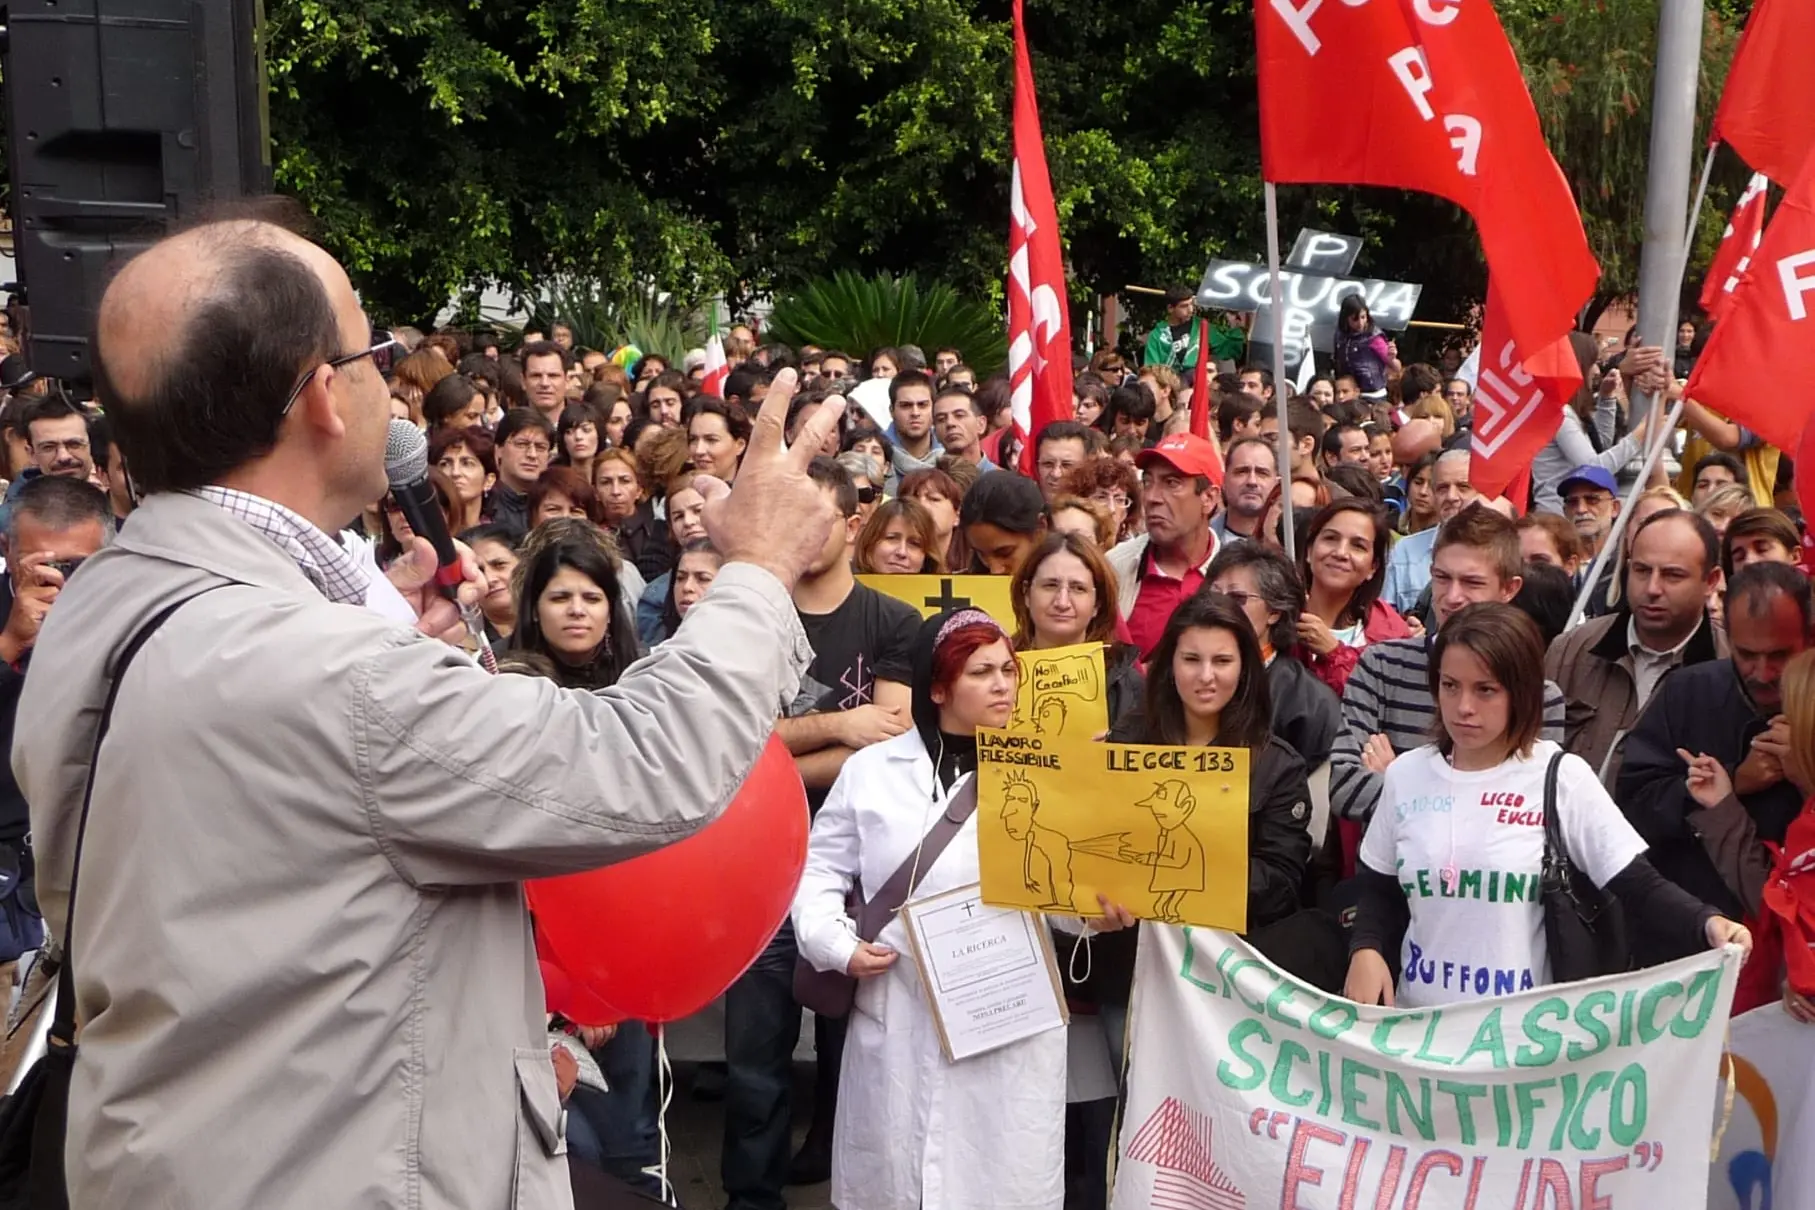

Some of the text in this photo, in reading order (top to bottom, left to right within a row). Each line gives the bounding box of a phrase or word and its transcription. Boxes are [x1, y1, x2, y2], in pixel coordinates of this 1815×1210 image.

[978, 732, 1043, 750] LAVORO
[979, 748, 1062, 770] FLESSIBILE
[1106, 749, 1235, 773] LEGGE 133
[1480, 792, 1525, 808] LICEO
[1405, 939, 1534, 996] BUFFONA
[1180, 927, 1725, 1069] LICEO CLASSICO
[1216, 1018, 1648, 1151] SCIENTIFICO
